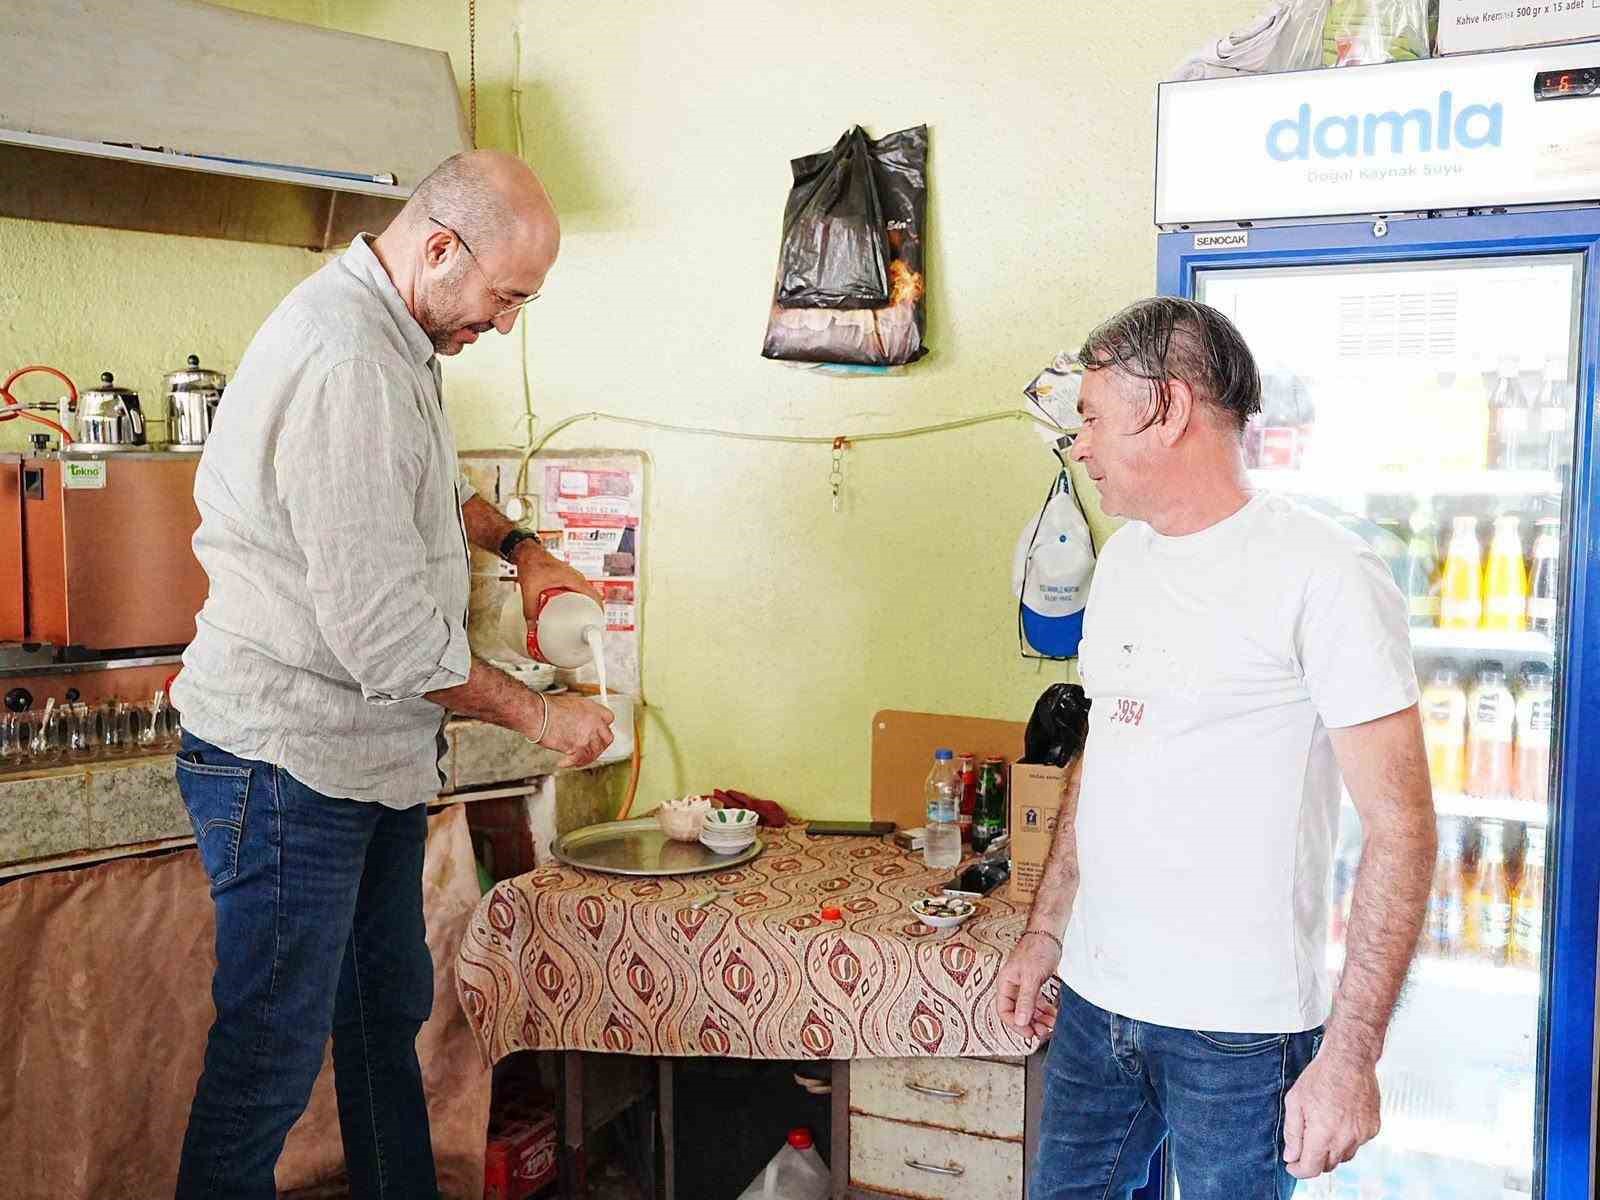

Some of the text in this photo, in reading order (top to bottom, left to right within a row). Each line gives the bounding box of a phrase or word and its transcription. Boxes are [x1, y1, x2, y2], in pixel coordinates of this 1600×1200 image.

[1456, 15, 1480, 26] Kahve
[1516, 7, 1531, 18] 500
[1532, 6, 1541, 18] gr
[1544, 6, 1550, 14] x
[1553, 3, 1562, 13] 15
[1566, 1, 1584, 11] adet
[1265, 90, 1503, 161] damla
